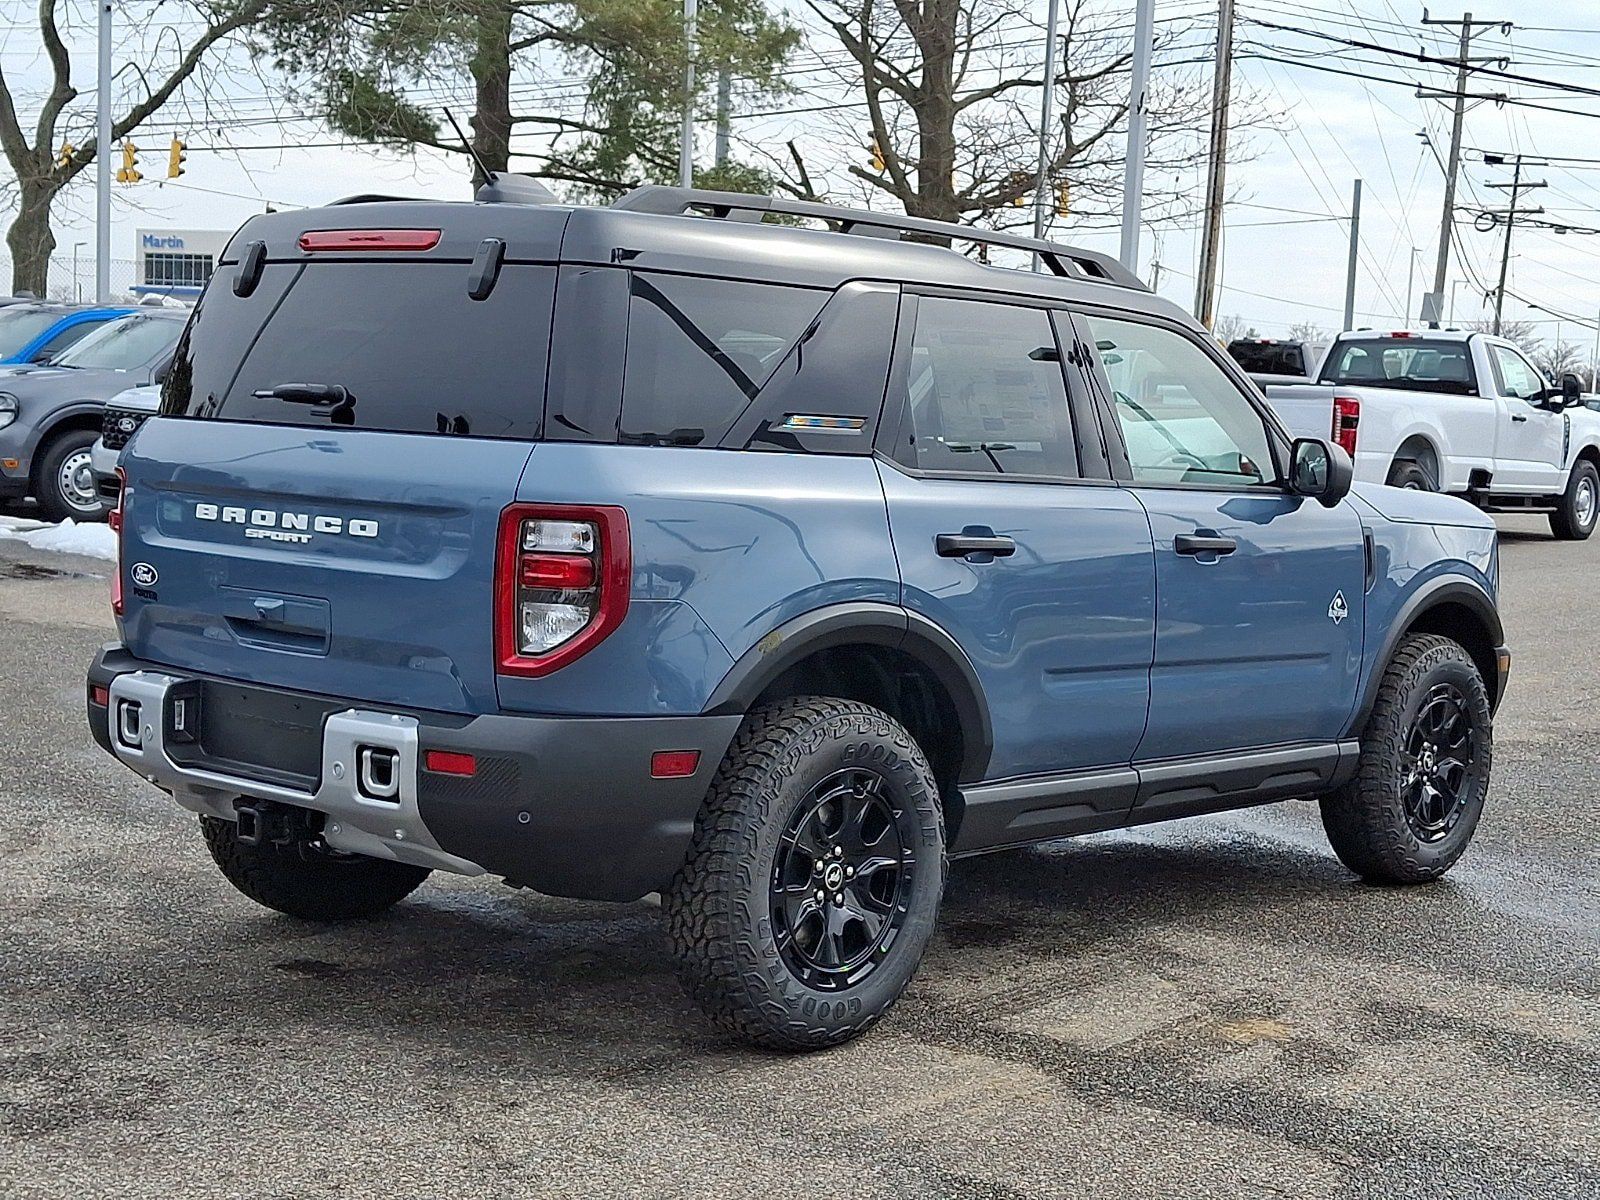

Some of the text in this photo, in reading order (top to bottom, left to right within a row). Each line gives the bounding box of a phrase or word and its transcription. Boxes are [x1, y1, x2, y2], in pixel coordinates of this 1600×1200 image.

[143, 234, 184, 248] Martin
[195, 503, 379, 537] BRONCO
[245, 528, 313, 544] SPORT
[134, 564, 154, 583] Ford
